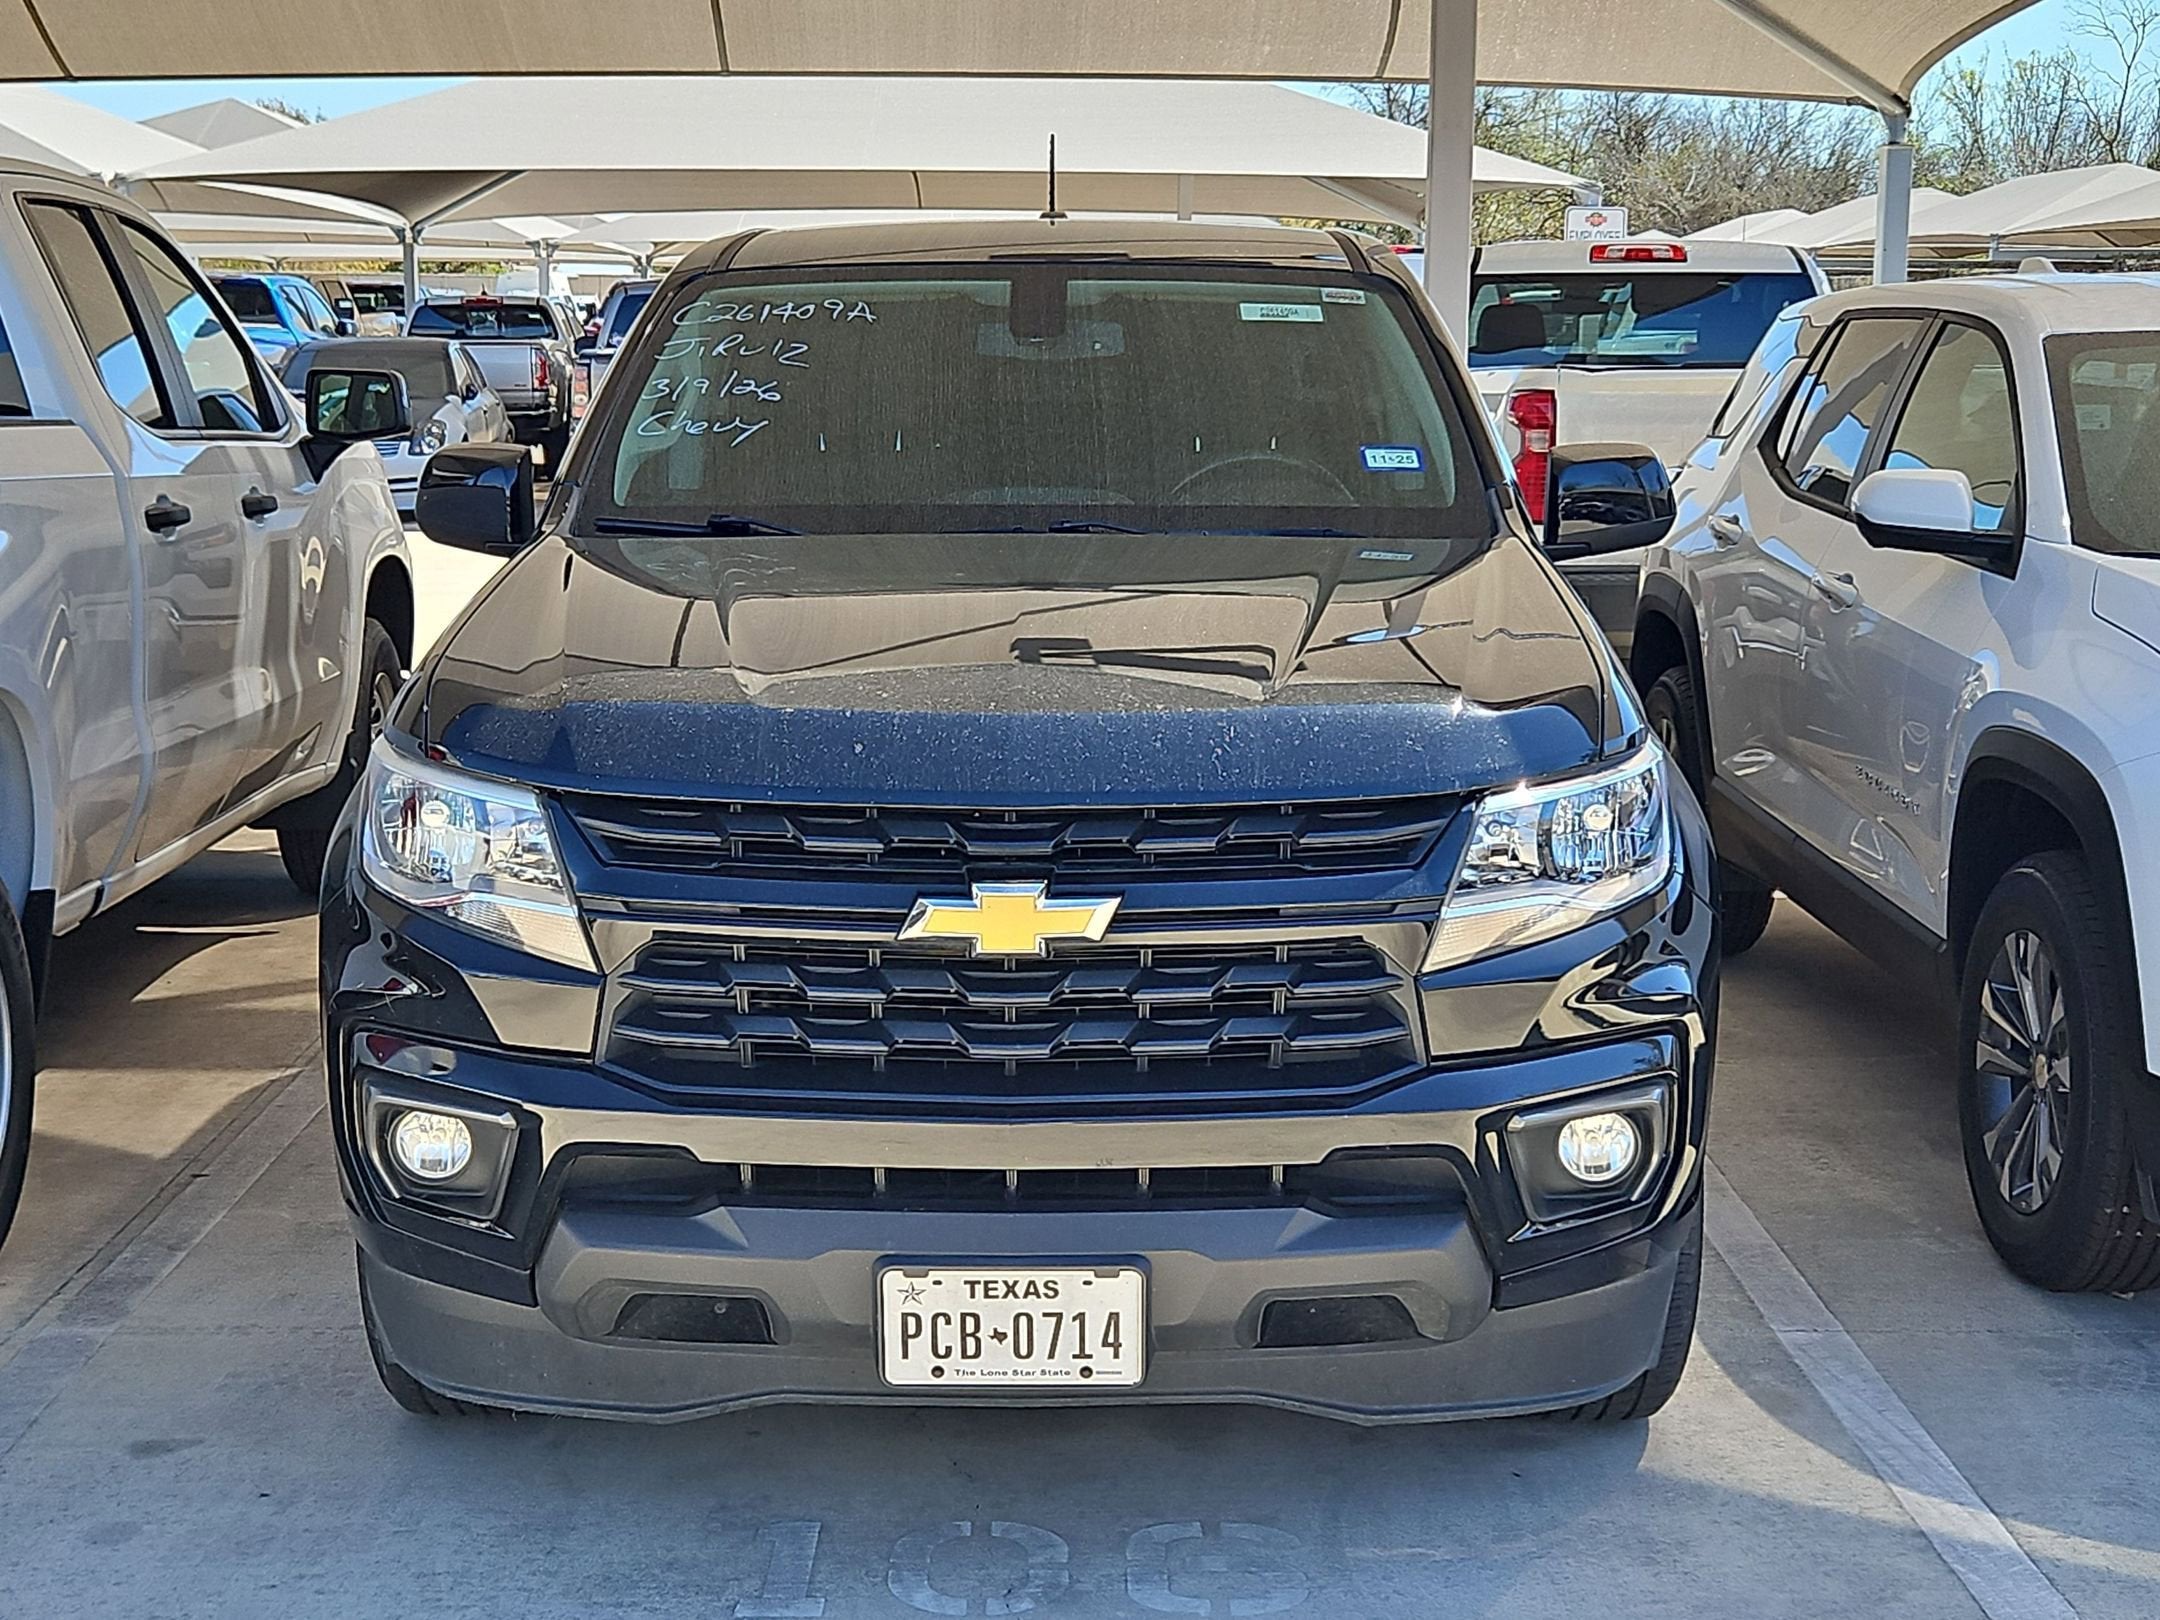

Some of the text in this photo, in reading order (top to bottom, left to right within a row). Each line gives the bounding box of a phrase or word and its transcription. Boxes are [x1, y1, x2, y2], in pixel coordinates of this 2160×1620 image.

[672, 298, 878, 326] C261409A
[641, 370, 782, 401] 3/9/26
[637, 410, 769, 447] Chevy
[963, 1279, 1060, 1300] TEXAS
[954, 1368, 1071, 1377] The Lone Star State
